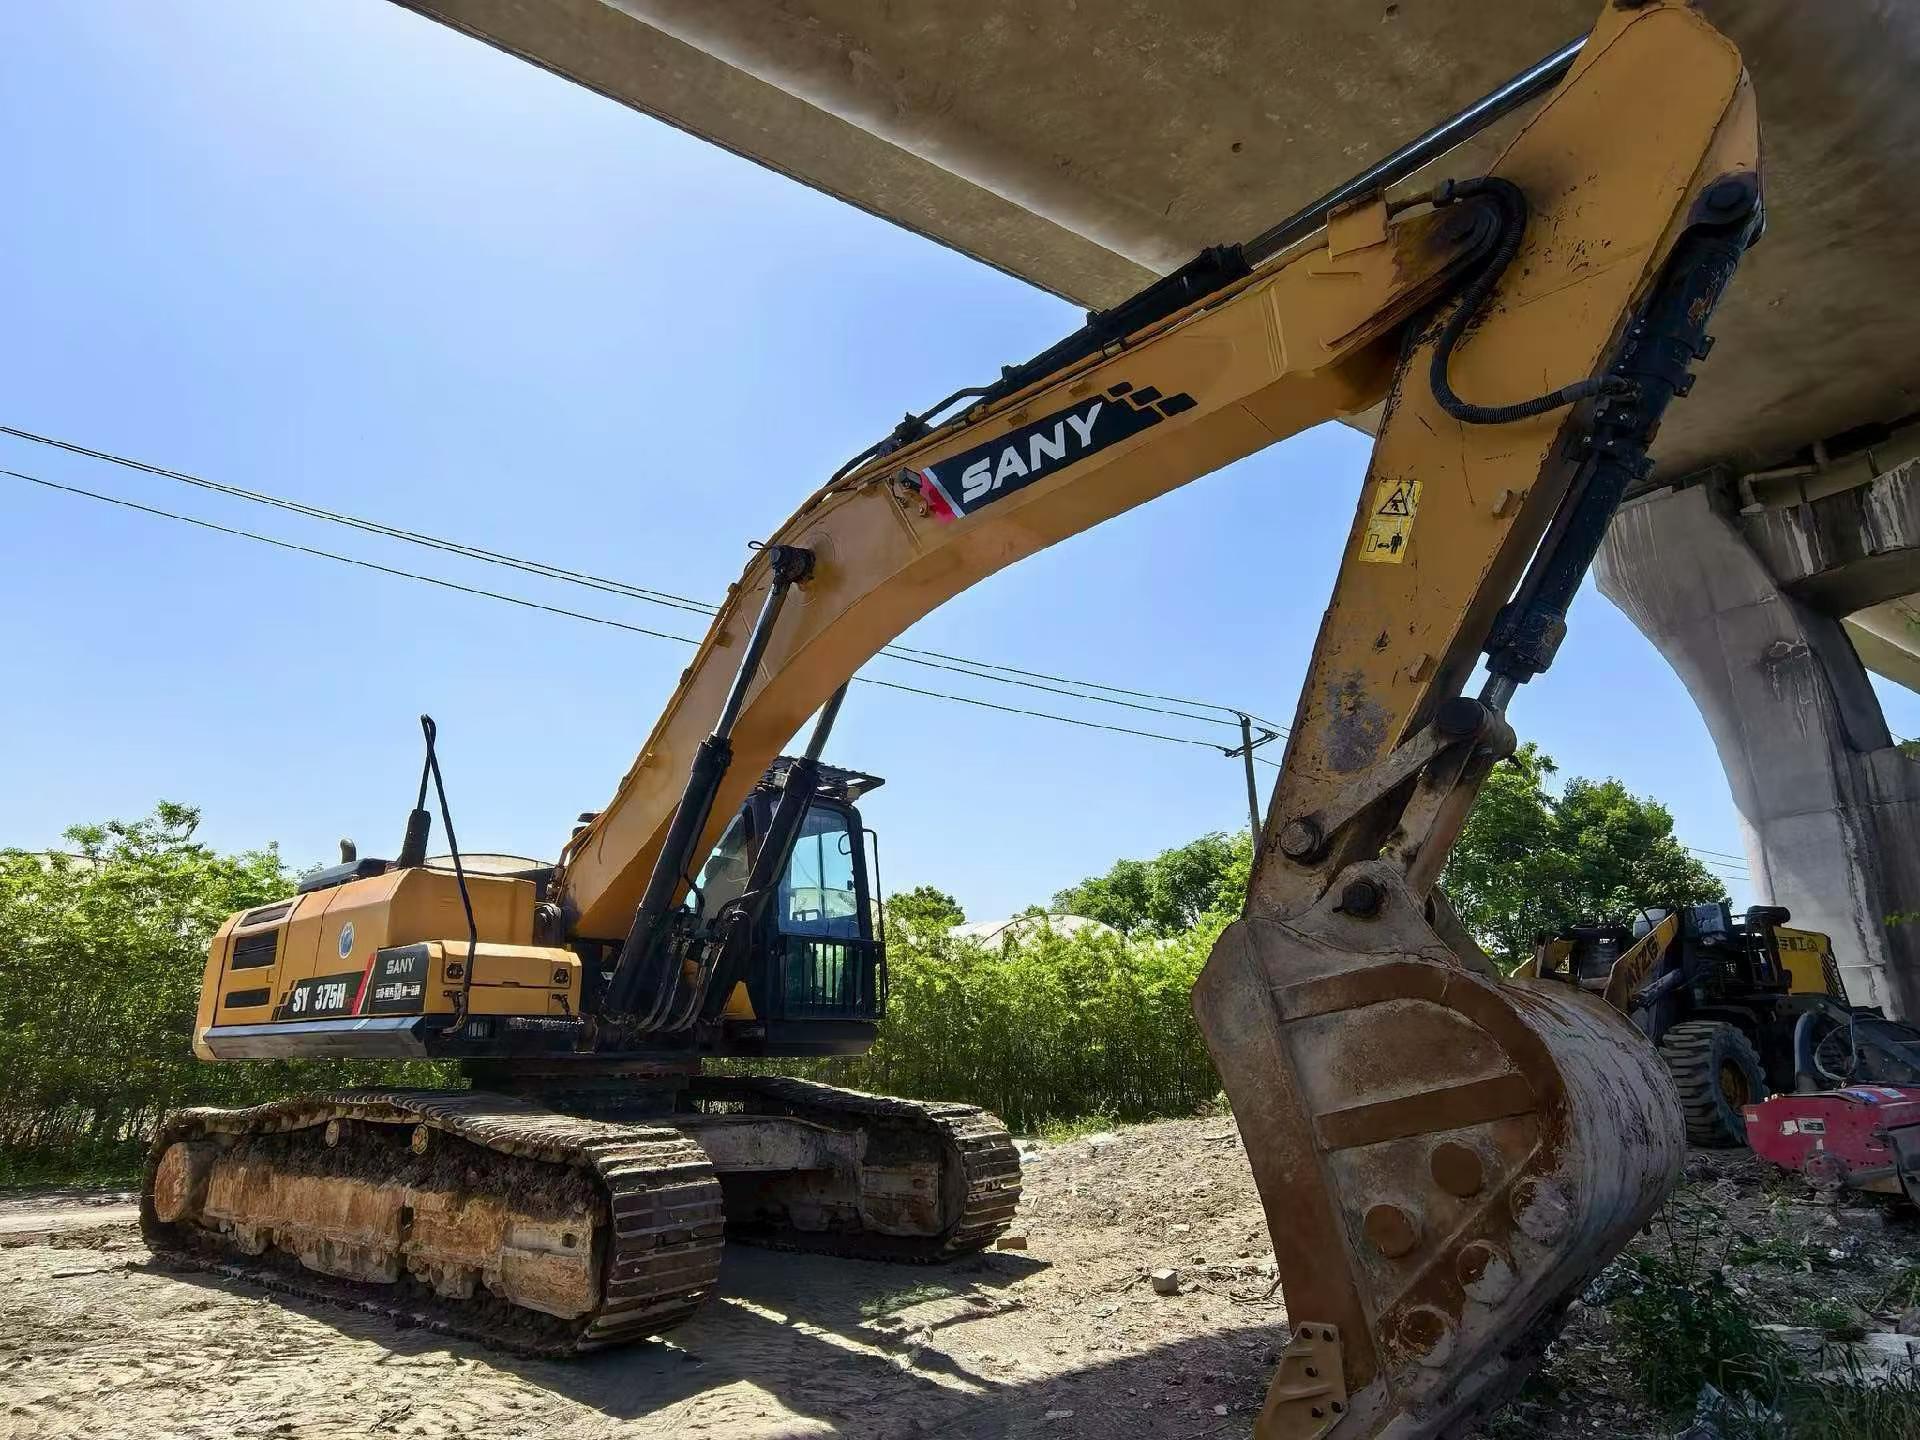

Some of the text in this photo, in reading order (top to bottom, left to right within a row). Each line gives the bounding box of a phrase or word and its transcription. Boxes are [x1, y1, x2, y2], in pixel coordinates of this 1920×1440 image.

[961, 402, 1103, 504] SANY
[386, 957, 415, 975] SANY
[292, 986, 311, 1012] SY
[314, 983, 347, 1010] 375H
